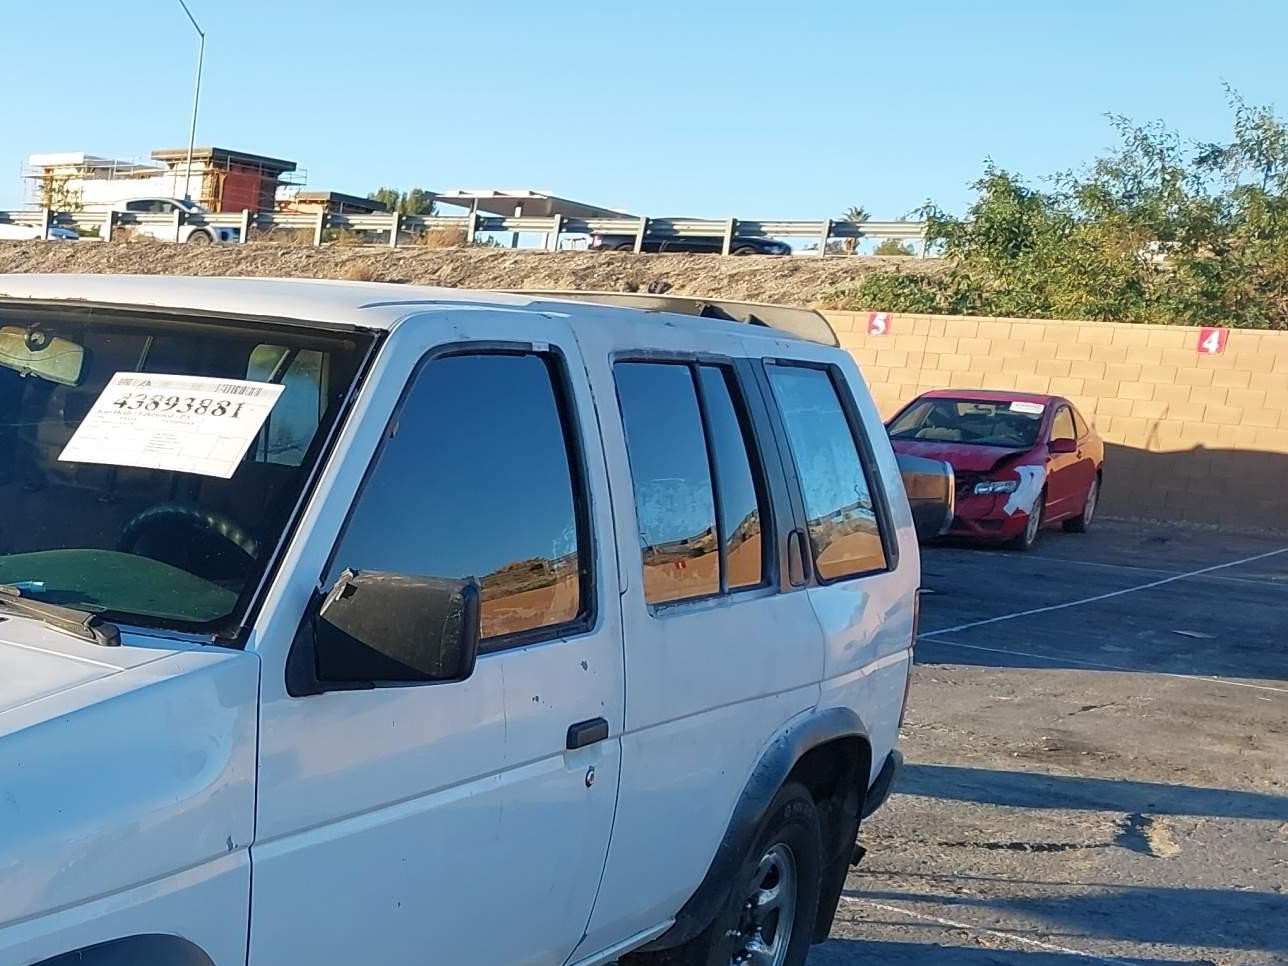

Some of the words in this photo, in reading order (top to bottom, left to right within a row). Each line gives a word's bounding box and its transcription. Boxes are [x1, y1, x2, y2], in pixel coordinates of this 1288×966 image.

[871, 312, 887, 335] 5
[1202, 328, 1220, 353] 4
[113, 393, 247, 419] 43893881
